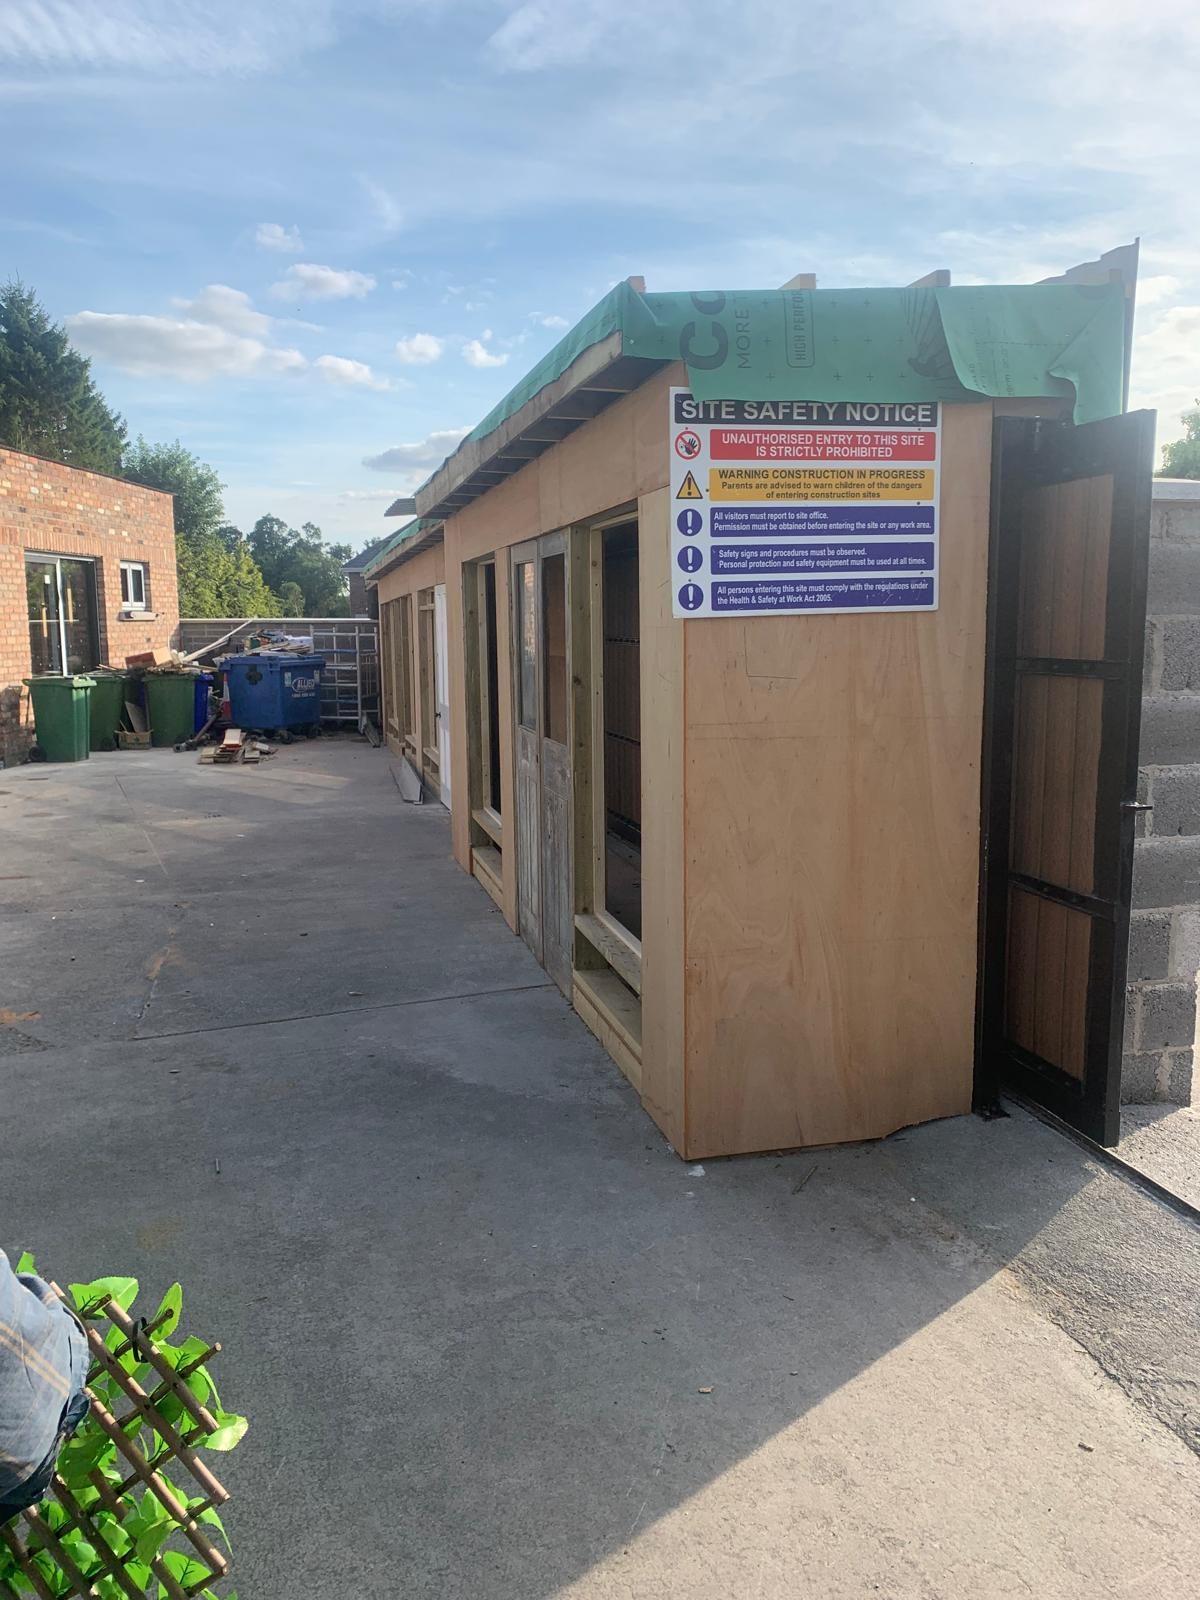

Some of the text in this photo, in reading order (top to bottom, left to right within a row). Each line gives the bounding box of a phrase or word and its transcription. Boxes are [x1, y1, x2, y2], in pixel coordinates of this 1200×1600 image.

[735, 307, 752, 369] MORE
[794, 336, 807, 360] HIGH
[681, 400, 932, 422] SITE SAFETY NOTICE
[722, 433, 925, 446] UNAUTHORISED ENTRY TO THIS SITE
[756, 446, 893, 457] IS STRICTLY PROHIBITED
[718, 469, 926, 479] WARNING CONSTRUCTION IN PROGRESS
[772, 481, 802, 489] advised
[834, 481, 865, 489] children
[867, 481, 875, 489] of
[877, 481, 889, 489] the
[891, 481, 922, 490] dangers
[765, 491, 774, 499] of
[776, 491, 808, 500] entering
[810, 491, 861, 499] construction
[714, 511, 829, 521] All visitors must report to site office.
[714, 522, 750, 531] Permission
[769, 522, 778, 530] be
[778, 522, 806, 530] obtained
[807, 522, 828, 530] before
[828, 521, 855, 531] entering
[855, 521, 866, 529] the
[867, 521, 879, 529] site
[887, 522, 899, 531] any
[900, 521, 915, 529] work
[916, 521, 931, 529] area.
[719, 547, 867, 559] Safety signs and procedures must be observed.
[719, 560, 748, 568] Personal
[749, 560, 781, 570] protection
[796, 559, 815, 568] safety
[816, 559, 849, 568] equipment
[850, 558, 866, 566] must
[876, 557, 892, 565] used
[899, 557, 908, 565] all
[908, 557, 927, 565] times.
[717, 586, 726, 594] All
[727, 586, 754, 596] persons
[754, 585, 781, 595] entering
[782, 584, 795, 593] this
[795, 584, 808, 592] site
[808, 584, 825, 592] must
[825, 583, 849, 593] comply
[849, 583, 863, 591] with
[875, 582, 909, 591] regulations
[910, 582, 929, 590] under
[717, 596, 728, 605] the
[729, 596, 750, 604] Health
[751, 596, 757, 604] &
[757, 595, 778, 605] Safety
[786, 595, 803, 603] Work
[804, 594, 815, 602] Act
[816, 594, 832, 602] 2005.
